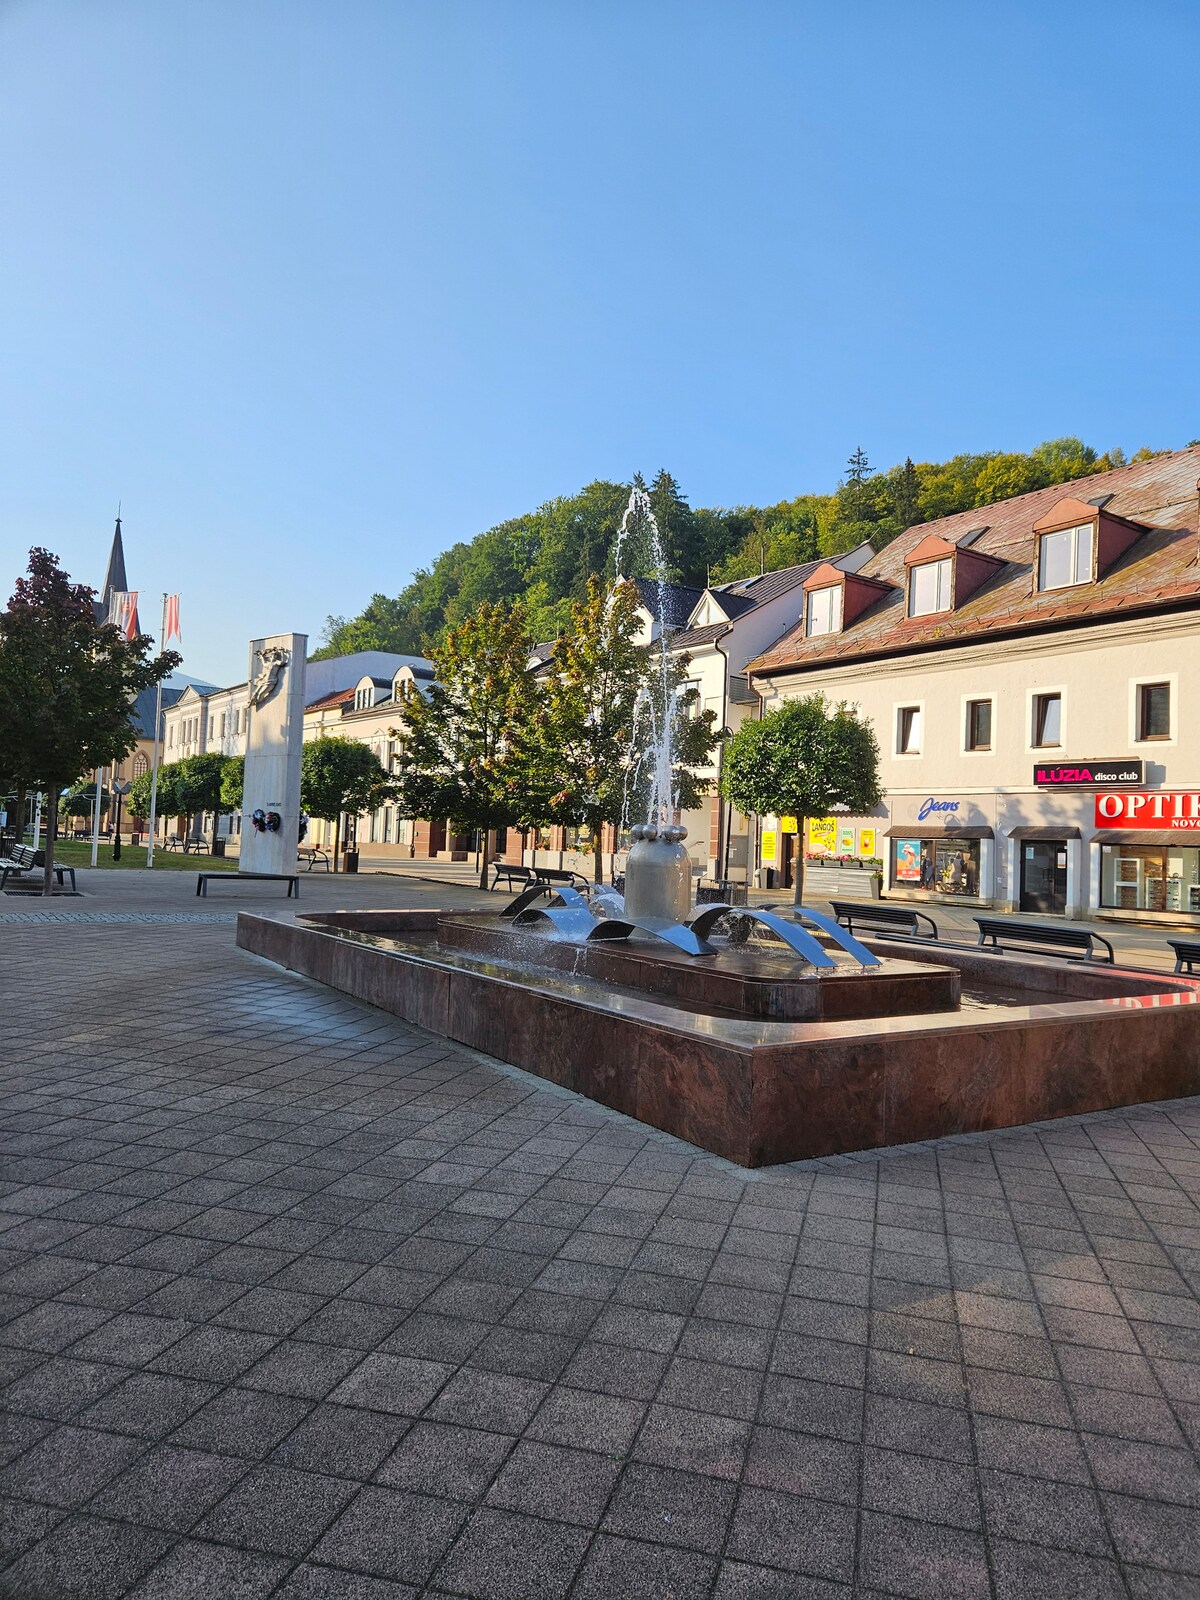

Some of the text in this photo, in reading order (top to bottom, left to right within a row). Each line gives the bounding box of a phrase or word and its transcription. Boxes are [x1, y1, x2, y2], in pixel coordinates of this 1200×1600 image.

[1037, 766, 1138, 782] ILÚZIA disco club
[918, 797, 960, 821] Jeans
